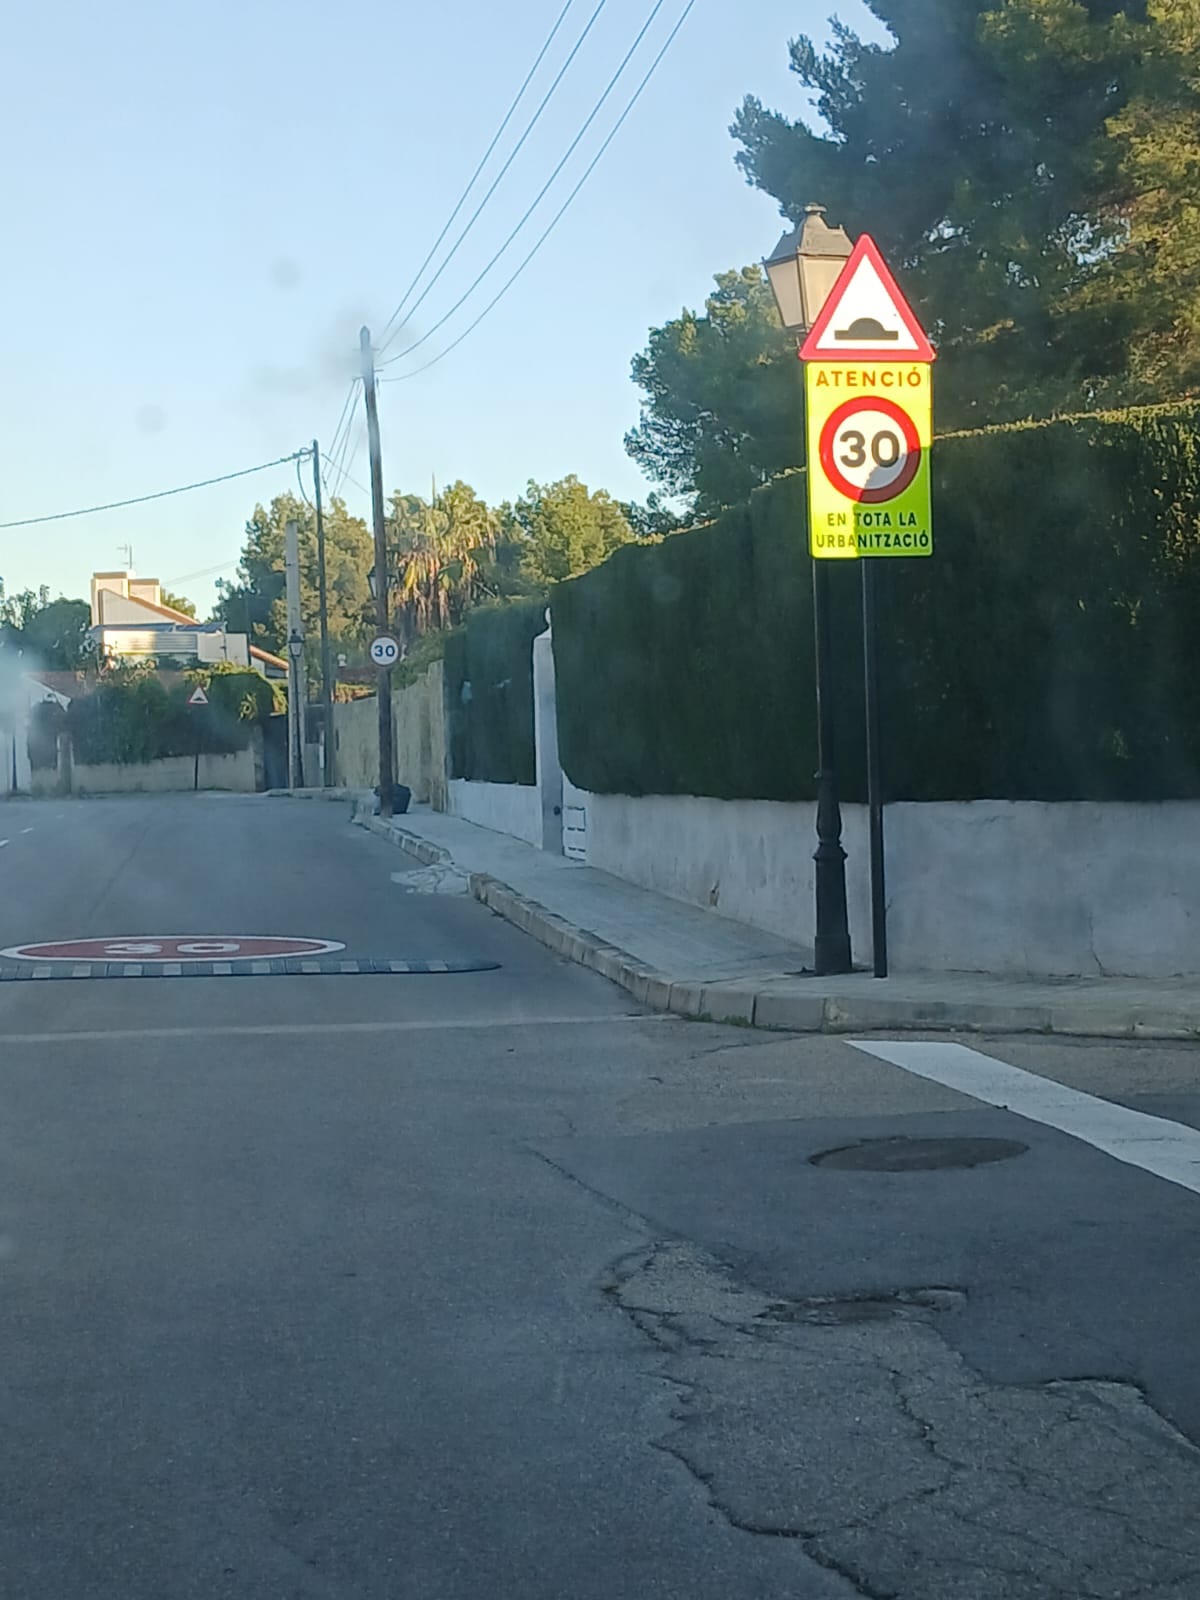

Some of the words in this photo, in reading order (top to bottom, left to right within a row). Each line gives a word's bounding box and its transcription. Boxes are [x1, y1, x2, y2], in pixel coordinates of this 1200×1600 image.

[816, 367, 922, 387] ATENCIÓ
[839, 430, 900, 468] 30
[827, 512, 846, 526] EN
[855, 512, 892, 526] TOTA
[899, 512, 917, 526] LA
[816, 530, 929, 548] URBANITZACIÓ
[374, 645, 396, 657] 30
[104, 942, 241, 955] 30
